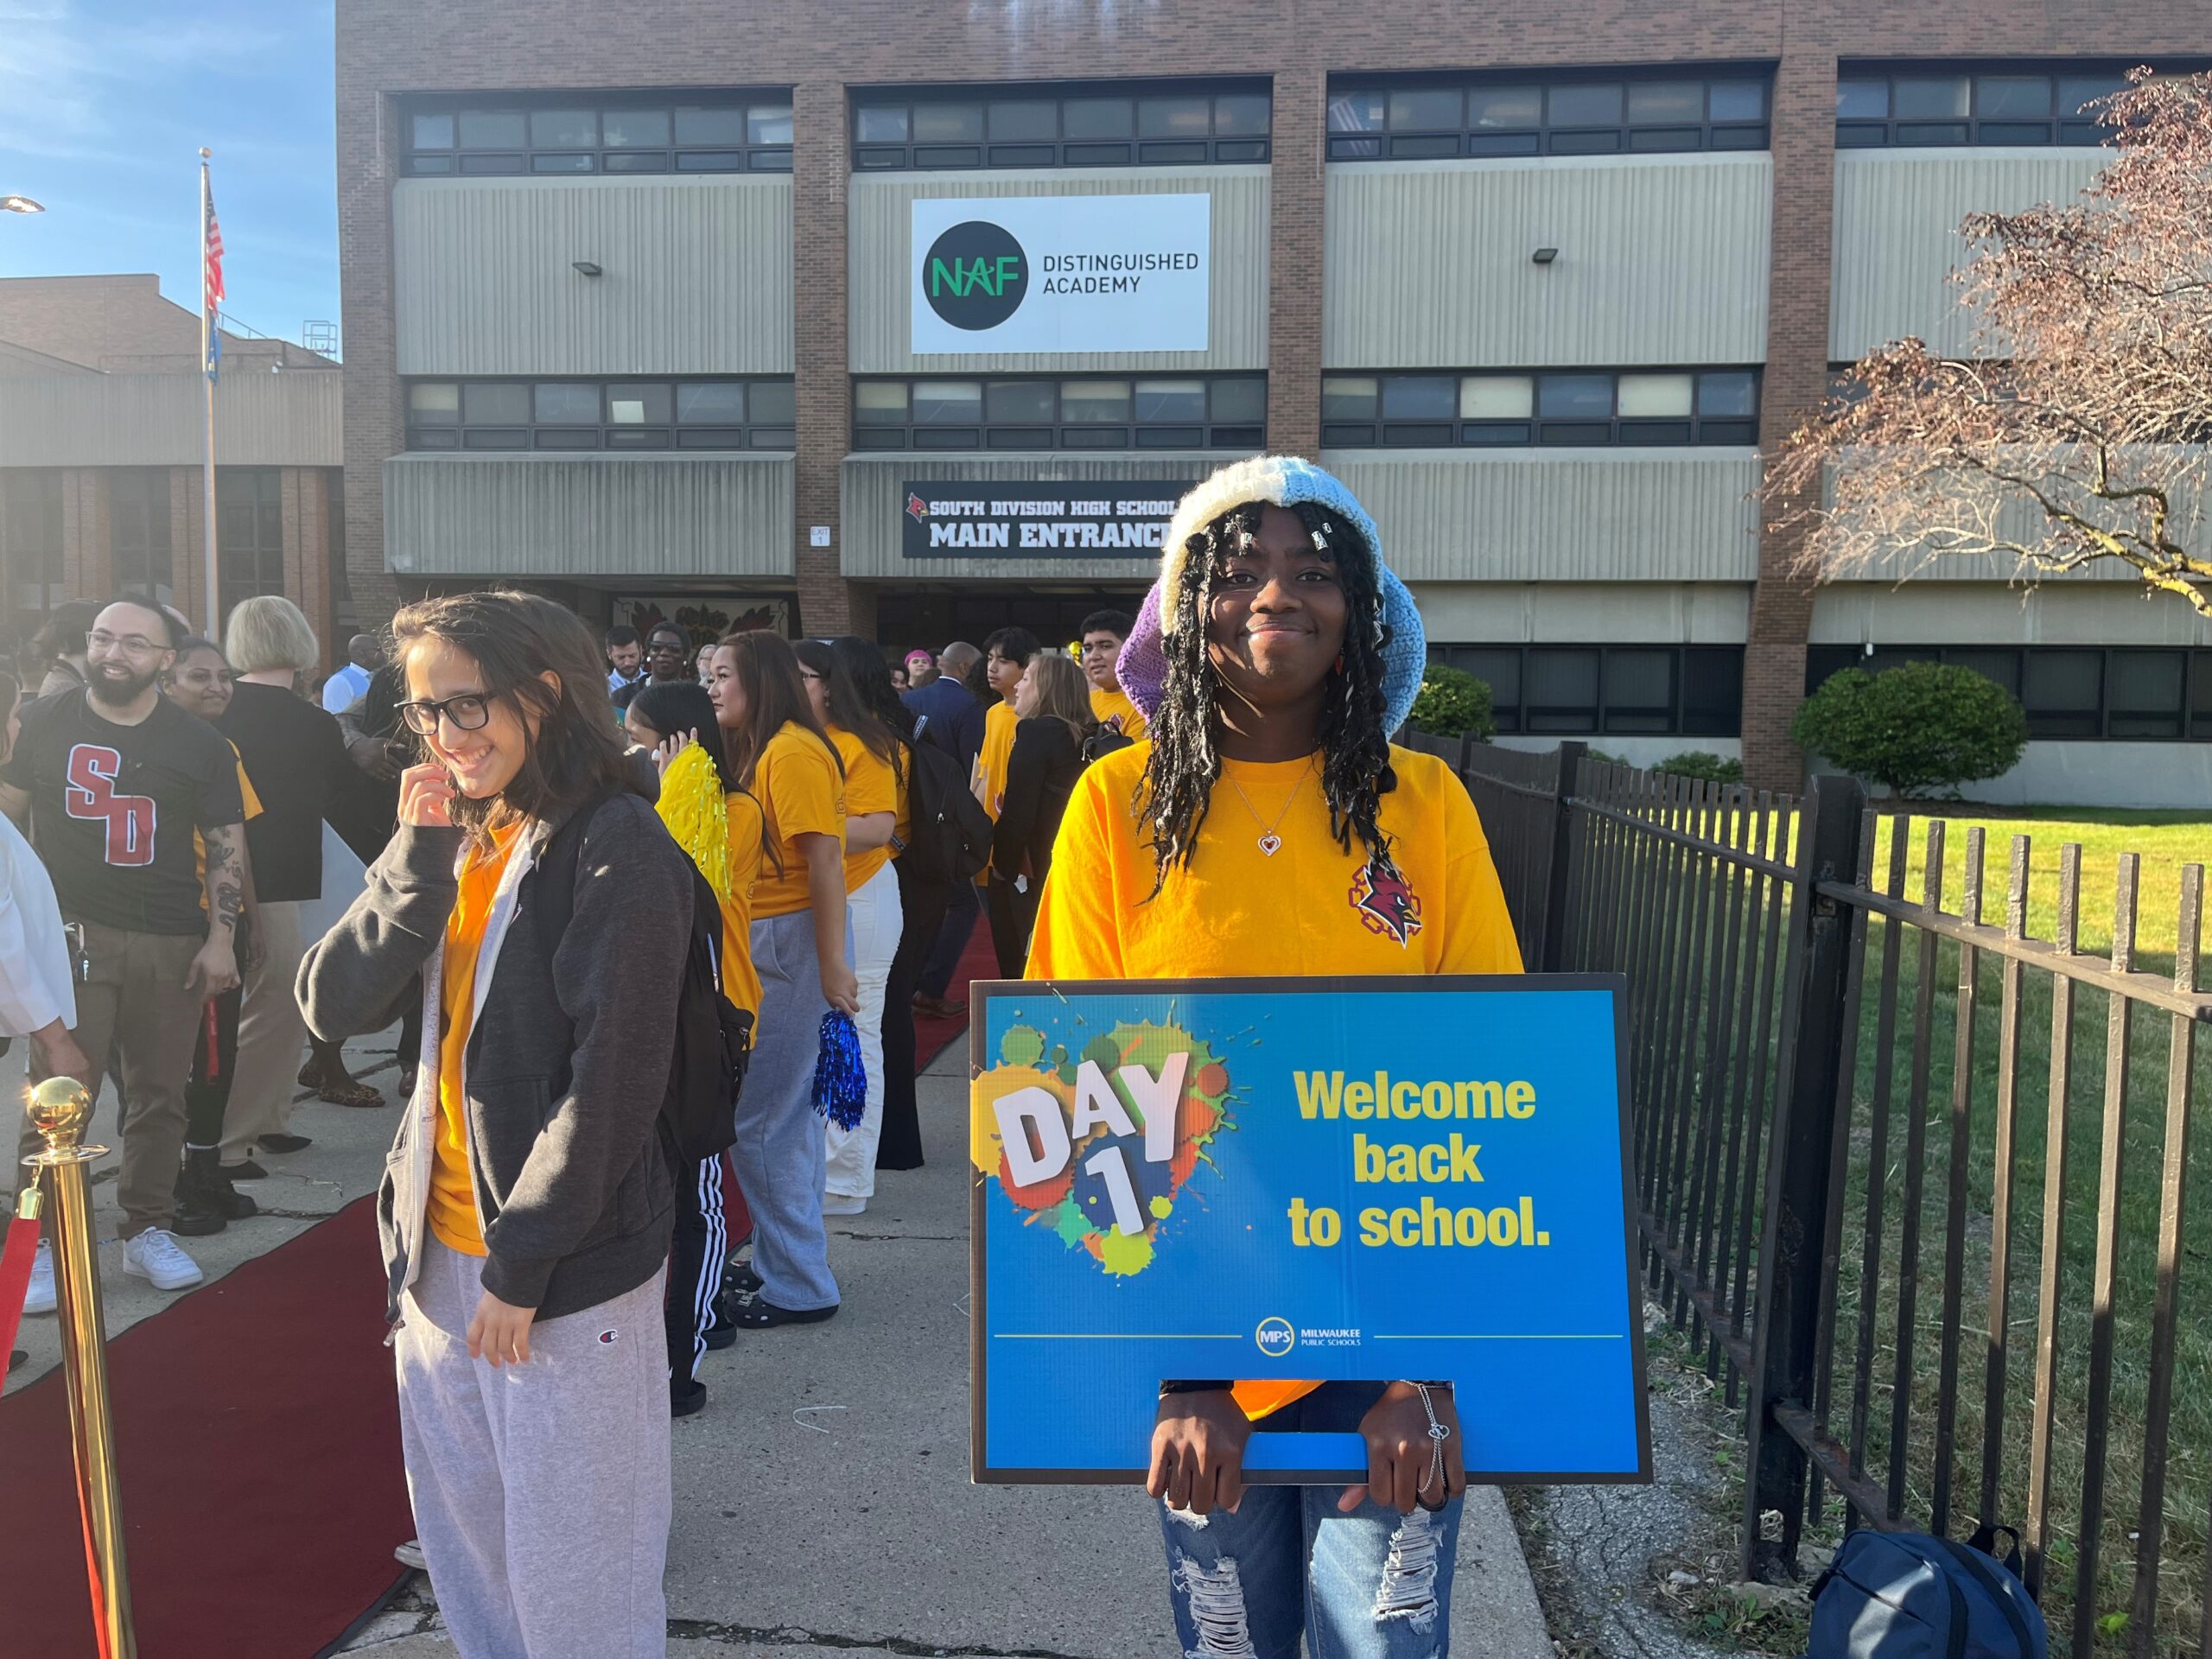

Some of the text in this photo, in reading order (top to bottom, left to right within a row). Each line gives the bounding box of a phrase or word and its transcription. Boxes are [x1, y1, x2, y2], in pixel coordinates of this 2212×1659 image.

[1043, 253, 1199, 272] DISTINGUISHED
[932, 257, 1019, 297] NAF
[1043, 276, 1141, 295] ACADEMY
[929, 500, 985, 516] SOUTH
[990, 500, 1065, 516] DIVISION
[1071, 500, 1111, 516] HIGH
[811, 527, 830, 536] EXIT
[930, 522, 1010, 548] MAIN
[1293, 1071, 1536, 1120] Welcome
[993, 1052, 1189, 1188] DAY
[1353, 1133, 1485, 1183] back
[1084, 1146, 1144, 1236] 1
[1287, 1196, 1550, 1247] to school.
[1261, 1331, 1291, 1343] MPS
[1300, 1329, 1361, 1338] MILWAUKEE
